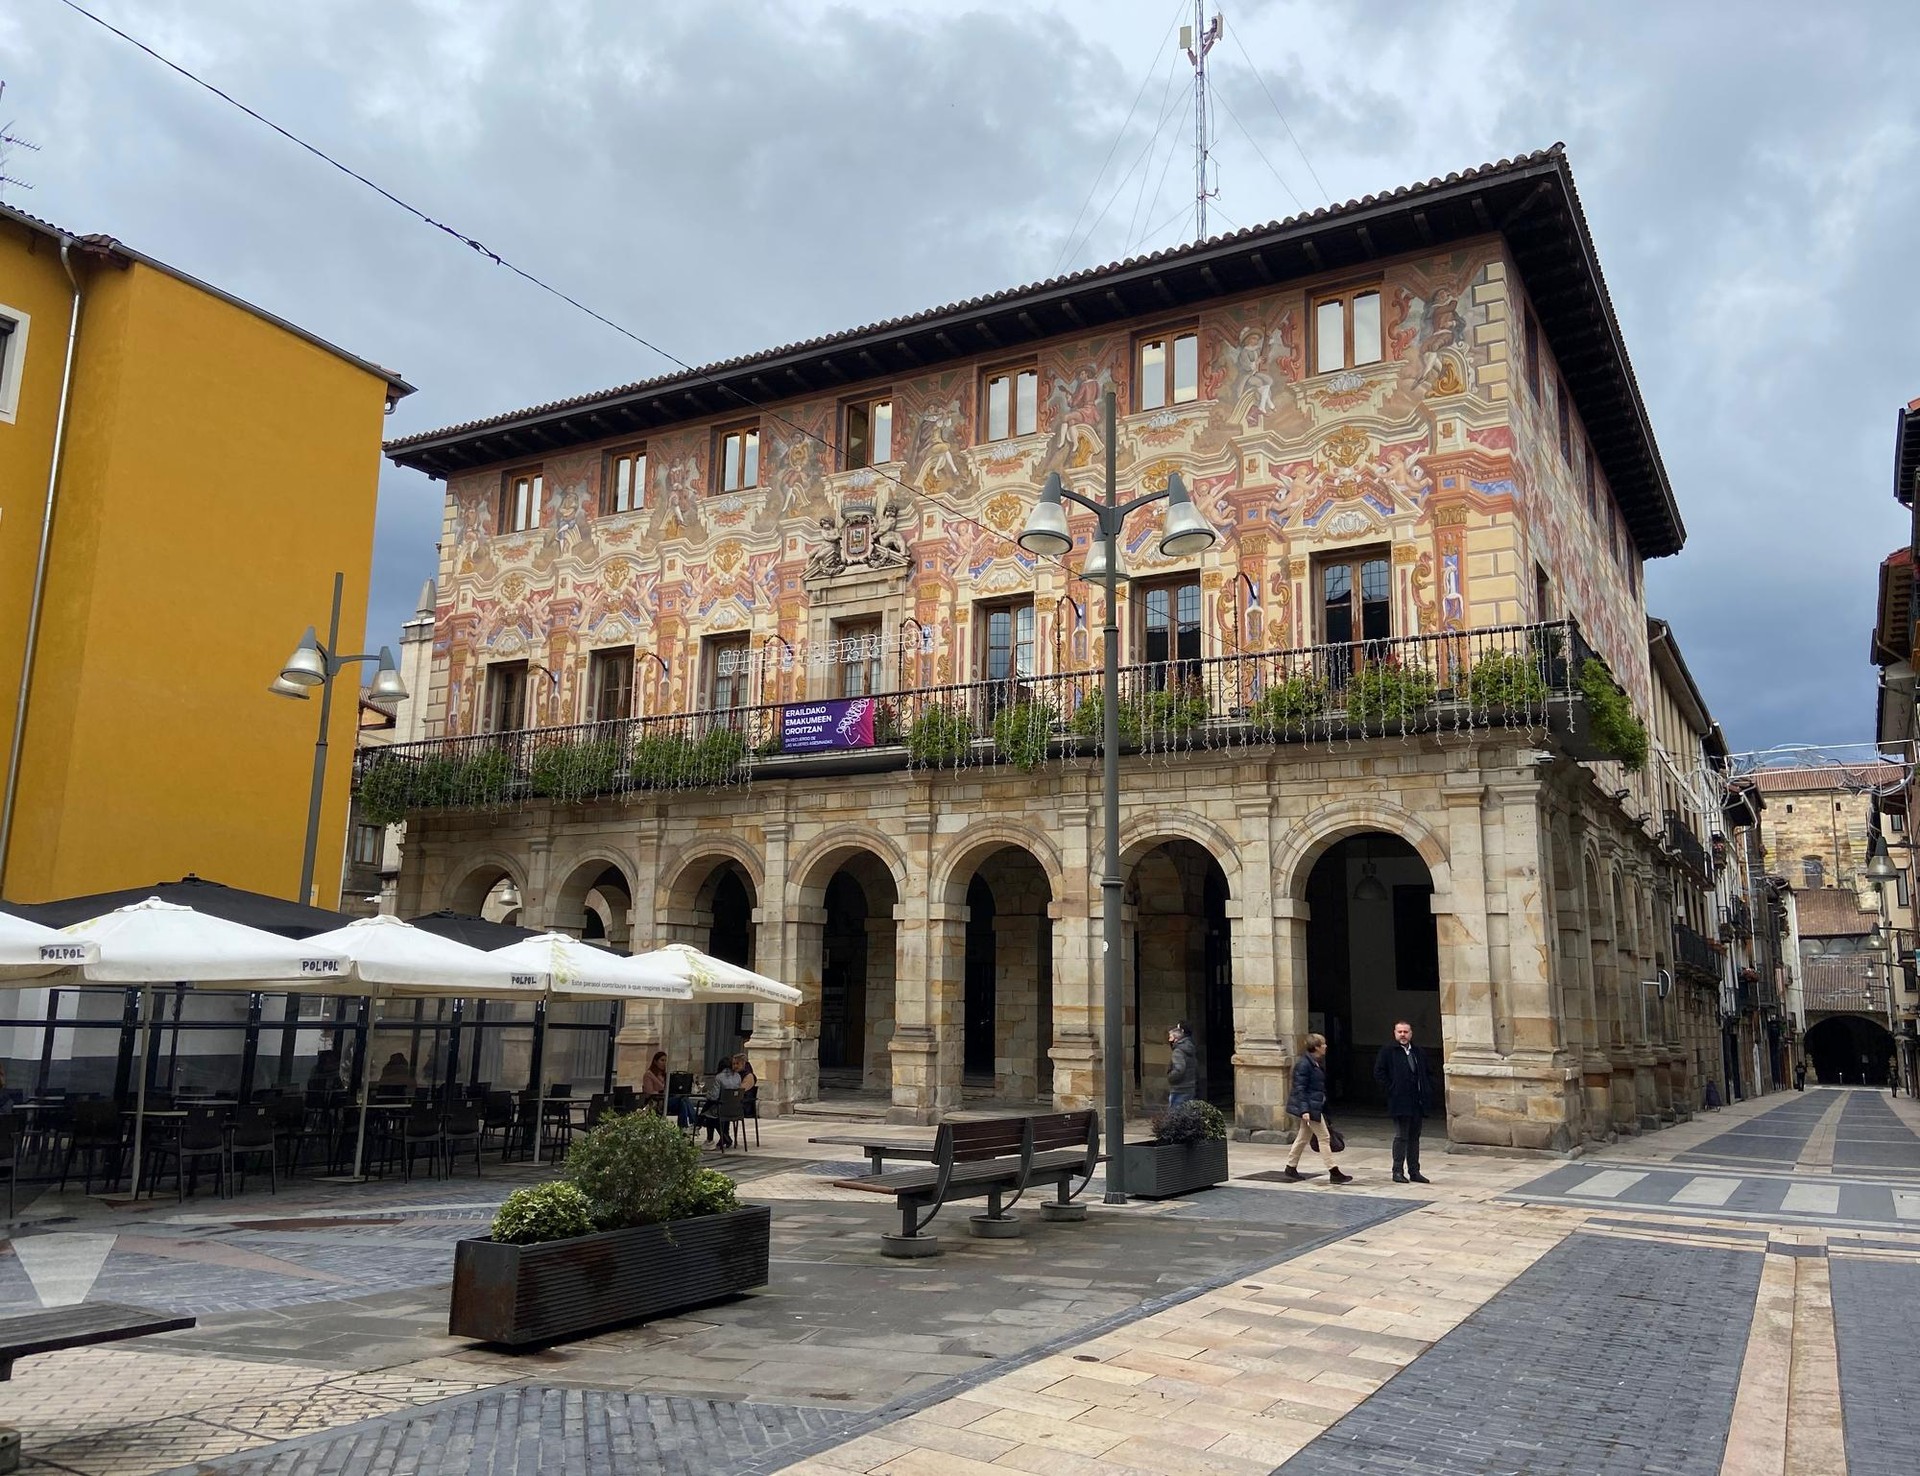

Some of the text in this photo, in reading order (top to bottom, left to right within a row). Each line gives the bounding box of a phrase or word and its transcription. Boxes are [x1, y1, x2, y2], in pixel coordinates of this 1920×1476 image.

[786, 706, 826, 717] ERAILDAKO
[786, 715, 832, 726] EMAKUMEEN
[786, 726, 822, 735] OROITZAN
[41, 949, 85, 960] POLPOL
[302, 961, 339, 971] POLPOL
[512, 976, 537, 984] POLPOL
[602, 982, 627, 990] contribuye
